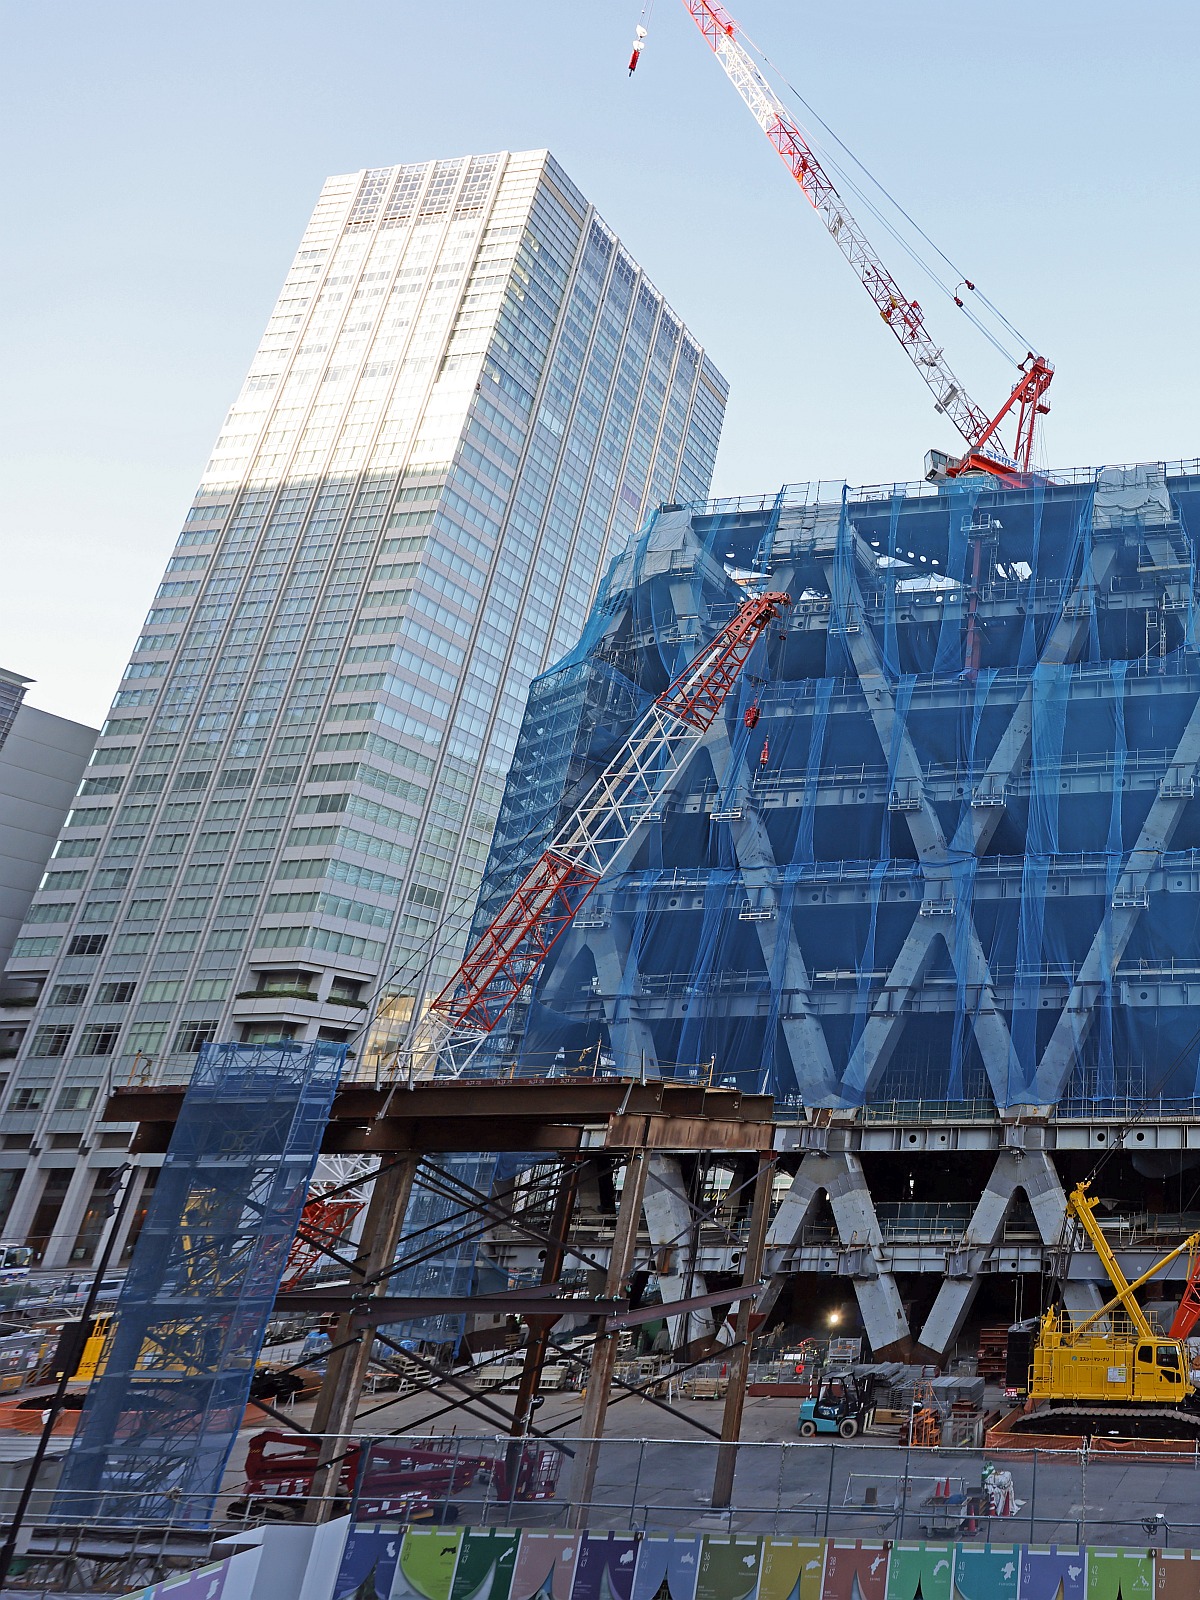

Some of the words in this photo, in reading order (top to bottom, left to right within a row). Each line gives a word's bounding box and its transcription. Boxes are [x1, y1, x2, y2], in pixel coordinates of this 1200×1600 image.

[443, 1458, 466, 1466] NAGNO
[463, 1544, 471, 1553] 32
[582, 1548, 589, 1556] 34
[461, 1556, 468, 1564] 47
[704, 1552, 710, 1561] 36
[580, 1559, 588, 1567] 47
[829, 1557, 836, 1565] 38
[893, 1559, 900, 1568] 39
[702, 1563, 710, 1572] 47
[765, 1566, 772, 1574] 47
[958, 1562, 966, 1570] 40
[1024, 1563, 1031, 1572] 41
[1091, 1566, 1098, 1574] 42
[828, 1568, 836, 1577] 47
[892, 1571, 899, 1580] 47
[1158, 1568, 1166, 1577] 43
[958, 1574, 965, 1582] 47
[1023, 1576, 1031, 1584] 47
[1091, 1578, 1098, 1587] 47
[1158, 1580, 1166, 1589] 47
